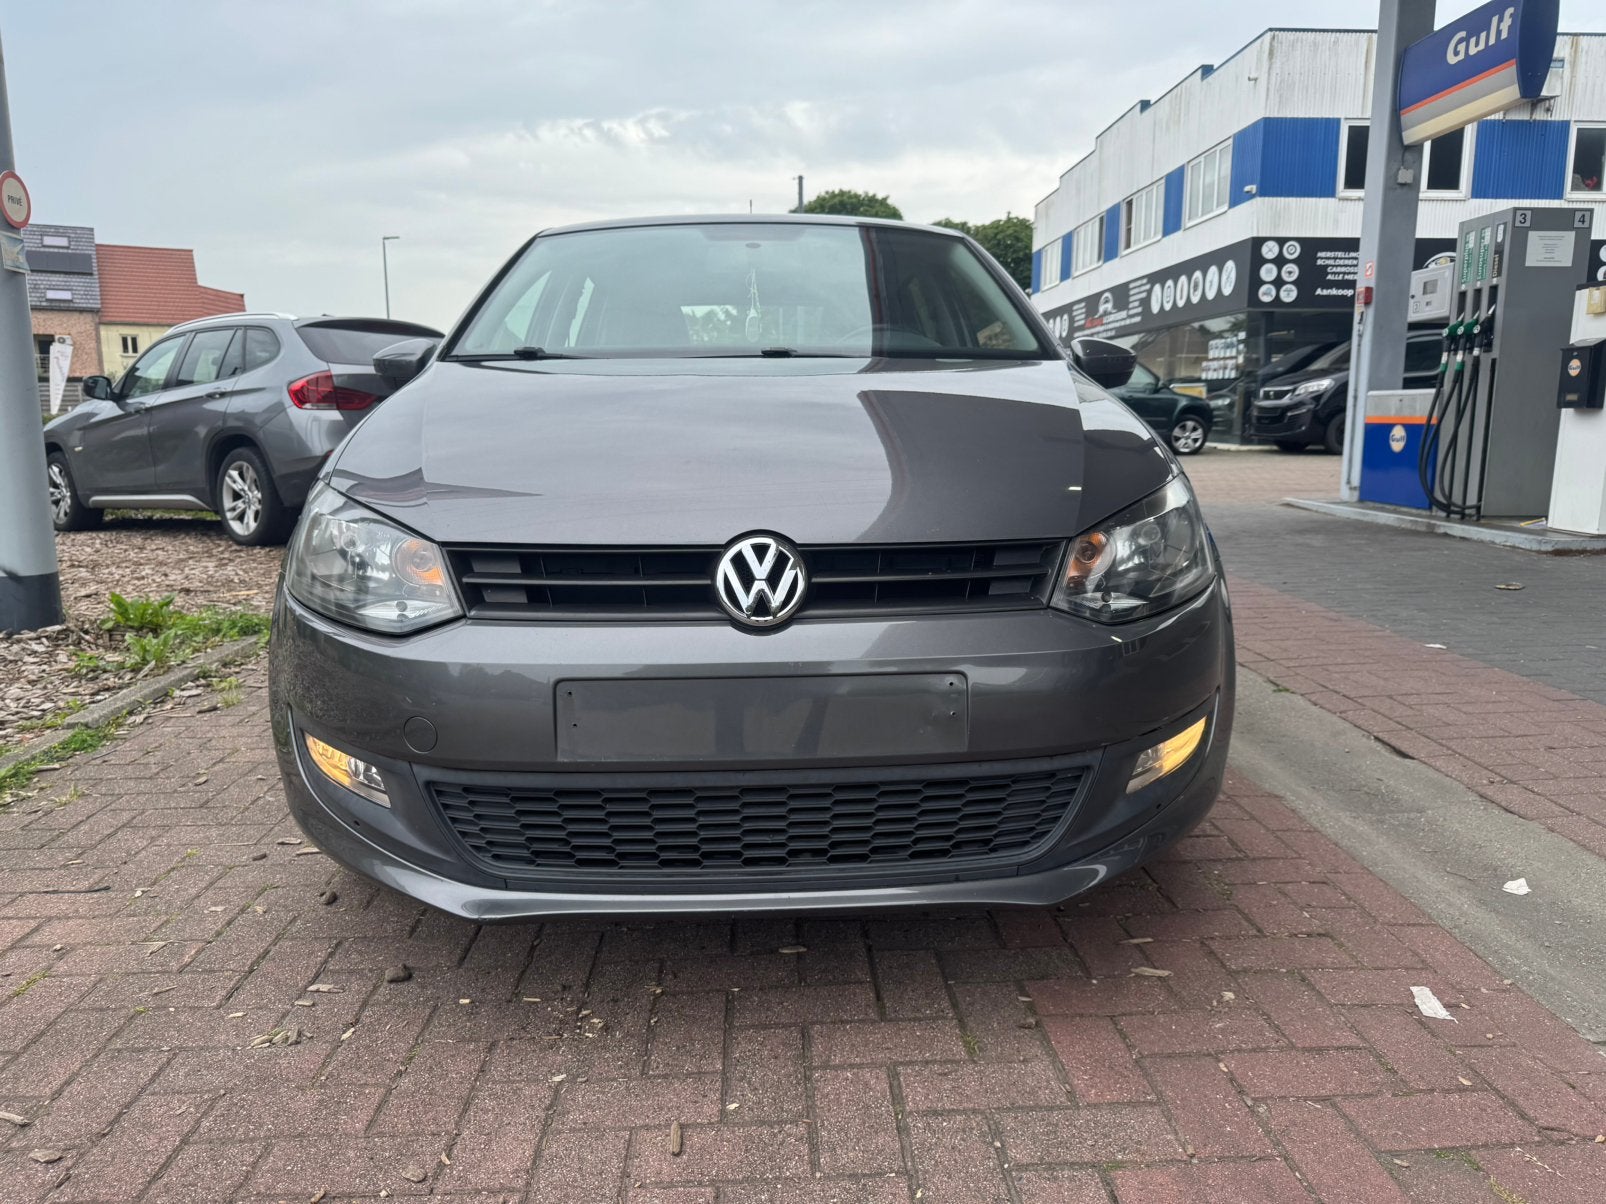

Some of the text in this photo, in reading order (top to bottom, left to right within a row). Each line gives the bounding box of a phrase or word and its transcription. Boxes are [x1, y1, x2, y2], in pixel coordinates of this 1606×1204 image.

[1446, 7, 1515, 65] Gulf
[1519, 213, 1527, 225] 3
[1578, 214, 1586, 225] 4
[1315, 288, 1354, 297] Aankoop
[720, 539, 802, 619] VW
